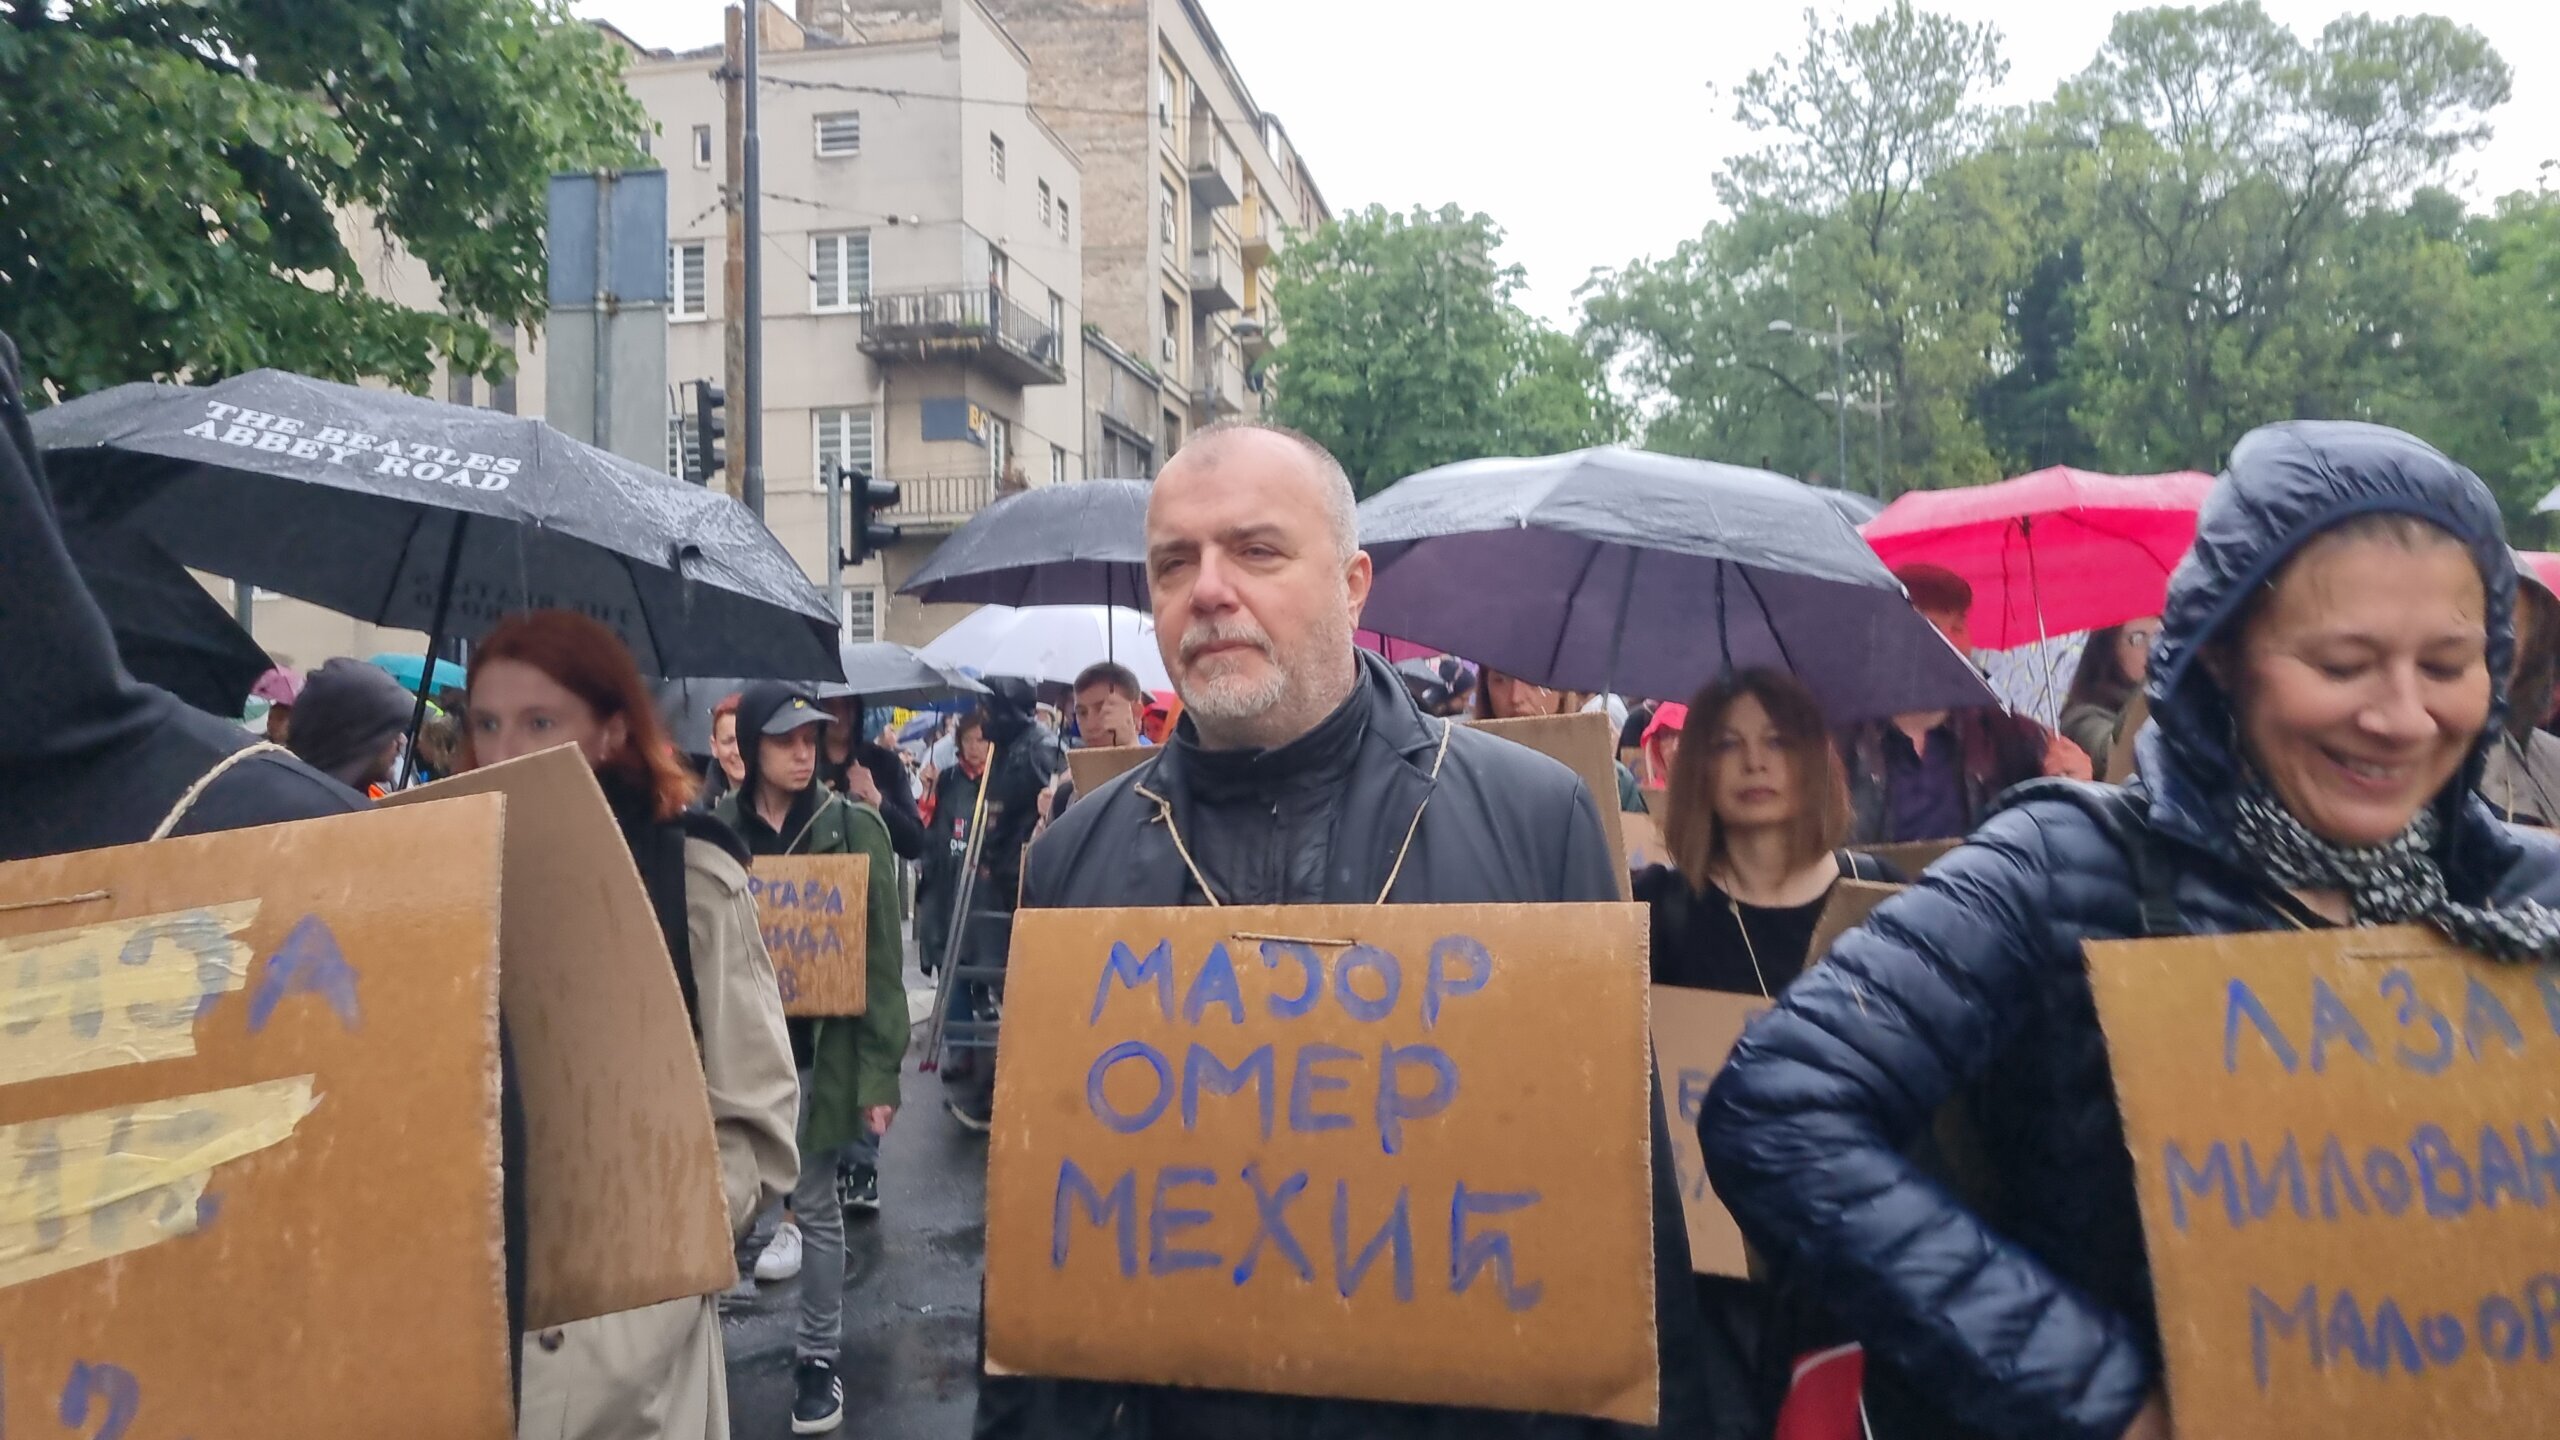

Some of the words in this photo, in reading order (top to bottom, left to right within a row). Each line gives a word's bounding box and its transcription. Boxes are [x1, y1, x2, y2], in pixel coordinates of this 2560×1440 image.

[184, 419, 362, 466] ABBEY
[374, 454, 511, 492] ROAD
[206, 400, 304, 435] THE
[314, 425, 522, 475] BEATLES
[1087, 1040, 1460, 1155] ОМЕР
[1052, 1157, 1544, 1314] МЕХИЋ
